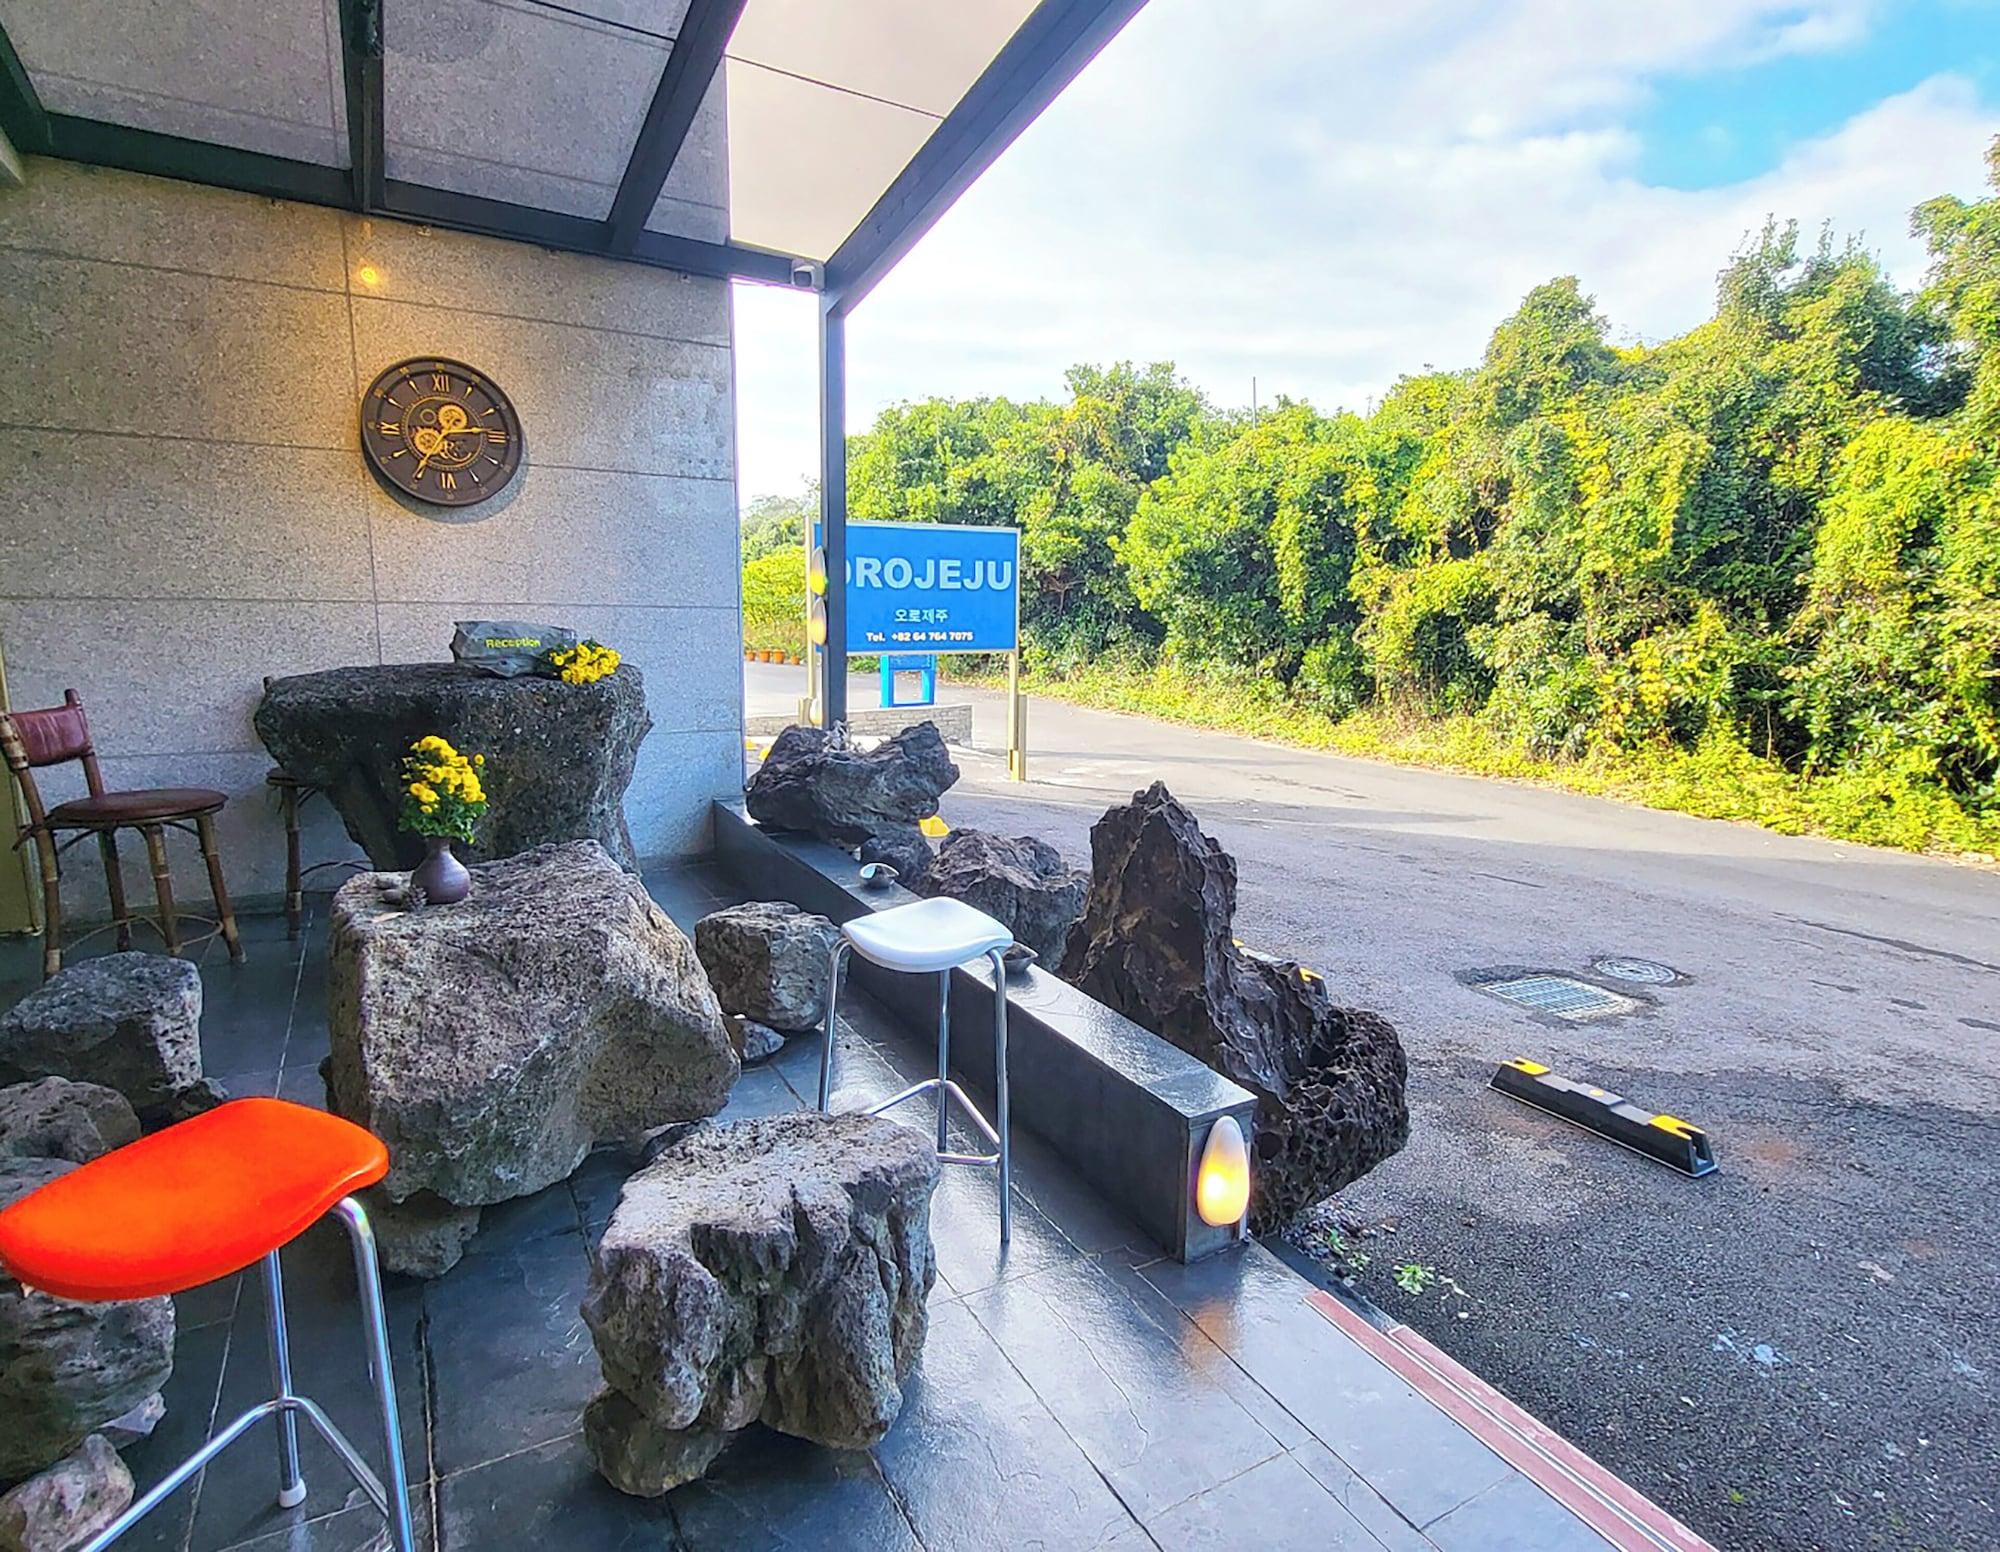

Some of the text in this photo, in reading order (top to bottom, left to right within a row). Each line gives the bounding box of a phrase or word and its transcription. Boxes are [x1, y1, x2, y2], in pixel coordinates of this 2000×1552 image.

[432, 375, 450, 392] XII
[845, 557, 1011, 590] ROJEJU
[894, 609, 948, 624] 오로제주
[485, 637, 541, 649] Reception
[866, 632, 973, 642] Tel. +82 64 764 7075
